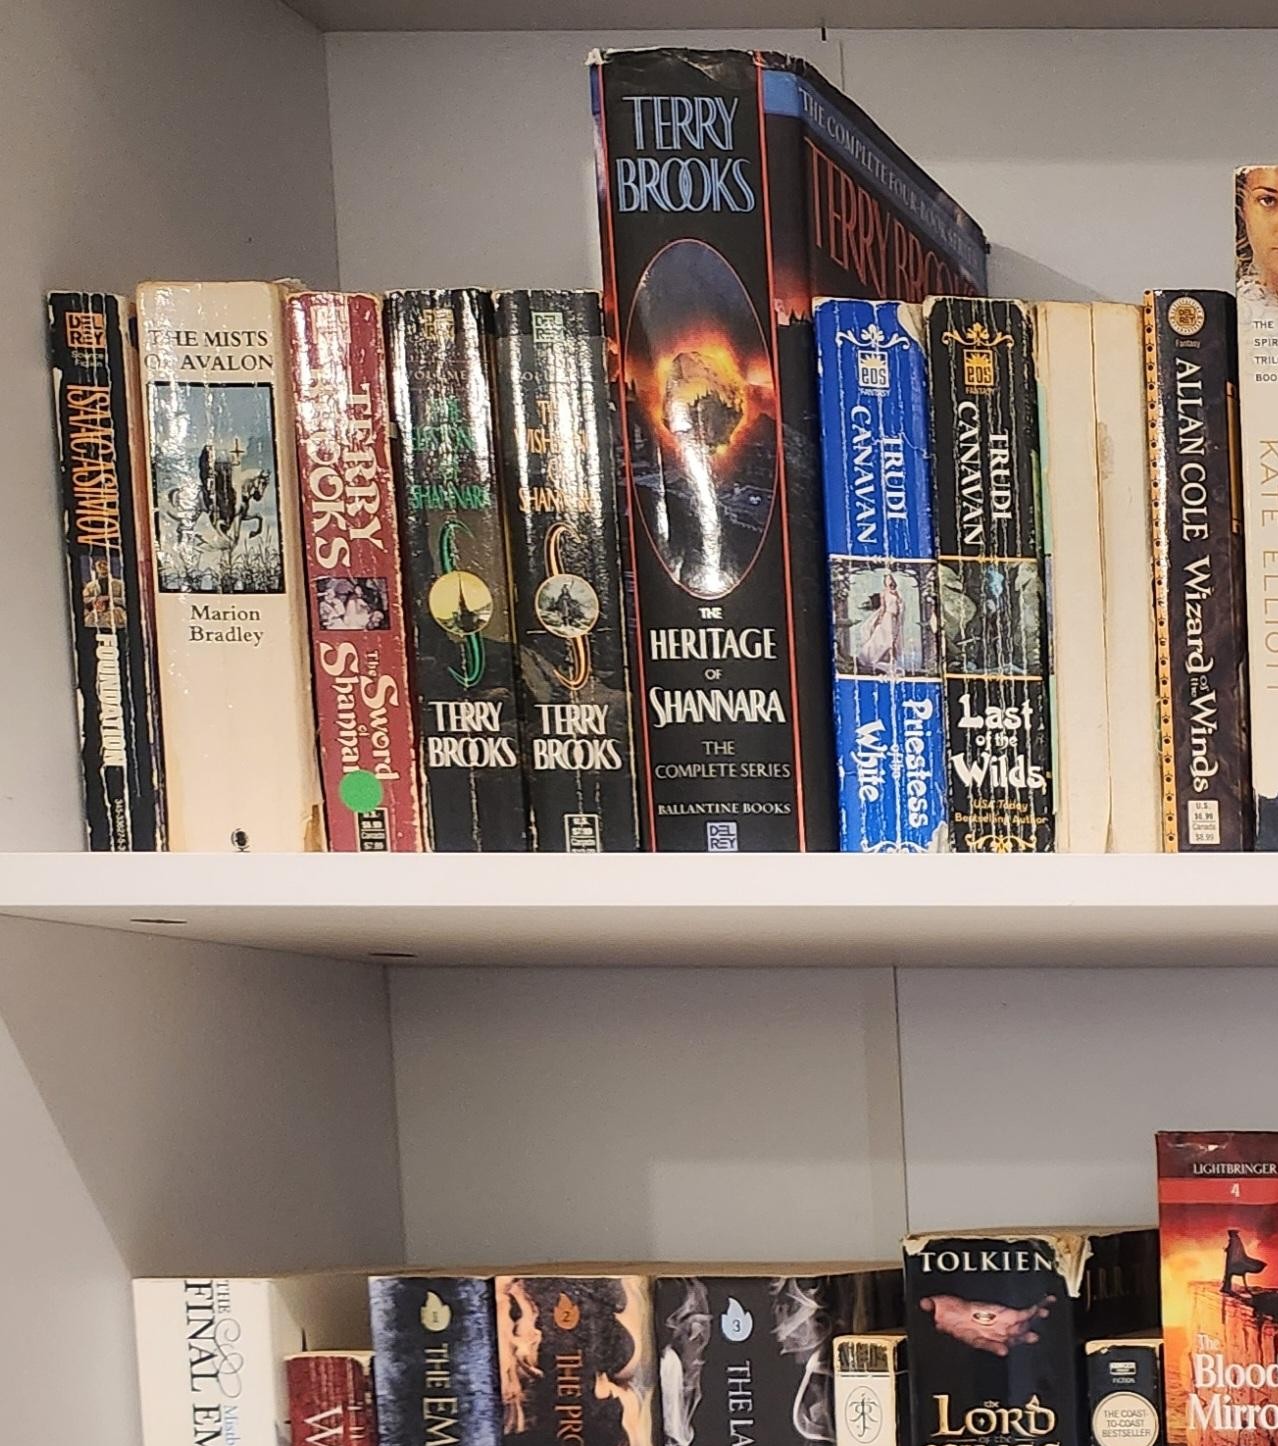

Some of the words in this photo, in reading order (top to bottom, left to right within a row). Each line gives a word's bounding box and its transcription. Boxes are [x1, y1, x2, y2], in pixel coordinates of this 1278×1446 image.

[622, 96, 738, 151] TERRY
[616, 158, 755, 212] BROOKS
[202, 329, 269, 347] MISTS
[1176, 358, 1206, 457] ALLAN
[1181, 461, 1208, 541] COLE
[190, 605, 261, 622] Marion
[188, 626, 264, 646] Bradley
[650, 628, 777, 660] HERITAGE
[652, 687, 786, 727] SHANNARA
[958, 695, 1033, 730] Last
[703, 741, 735, 755] THE
[655, 763, 736, 779] COMPLETE
[738, 763, 791, 778] SERIES
[951, 750, 1047, 789] Wilds
[657, 802, 739, 815] BALLANTINE
[742, 801, 791, 815] BOOKS
[1193, 1163, 1277, 1175] LIGHTBRINGER
[919, 1251, 1056, 1274] TOLKIEN
[183, 1281, 218, 1393] FINAL
